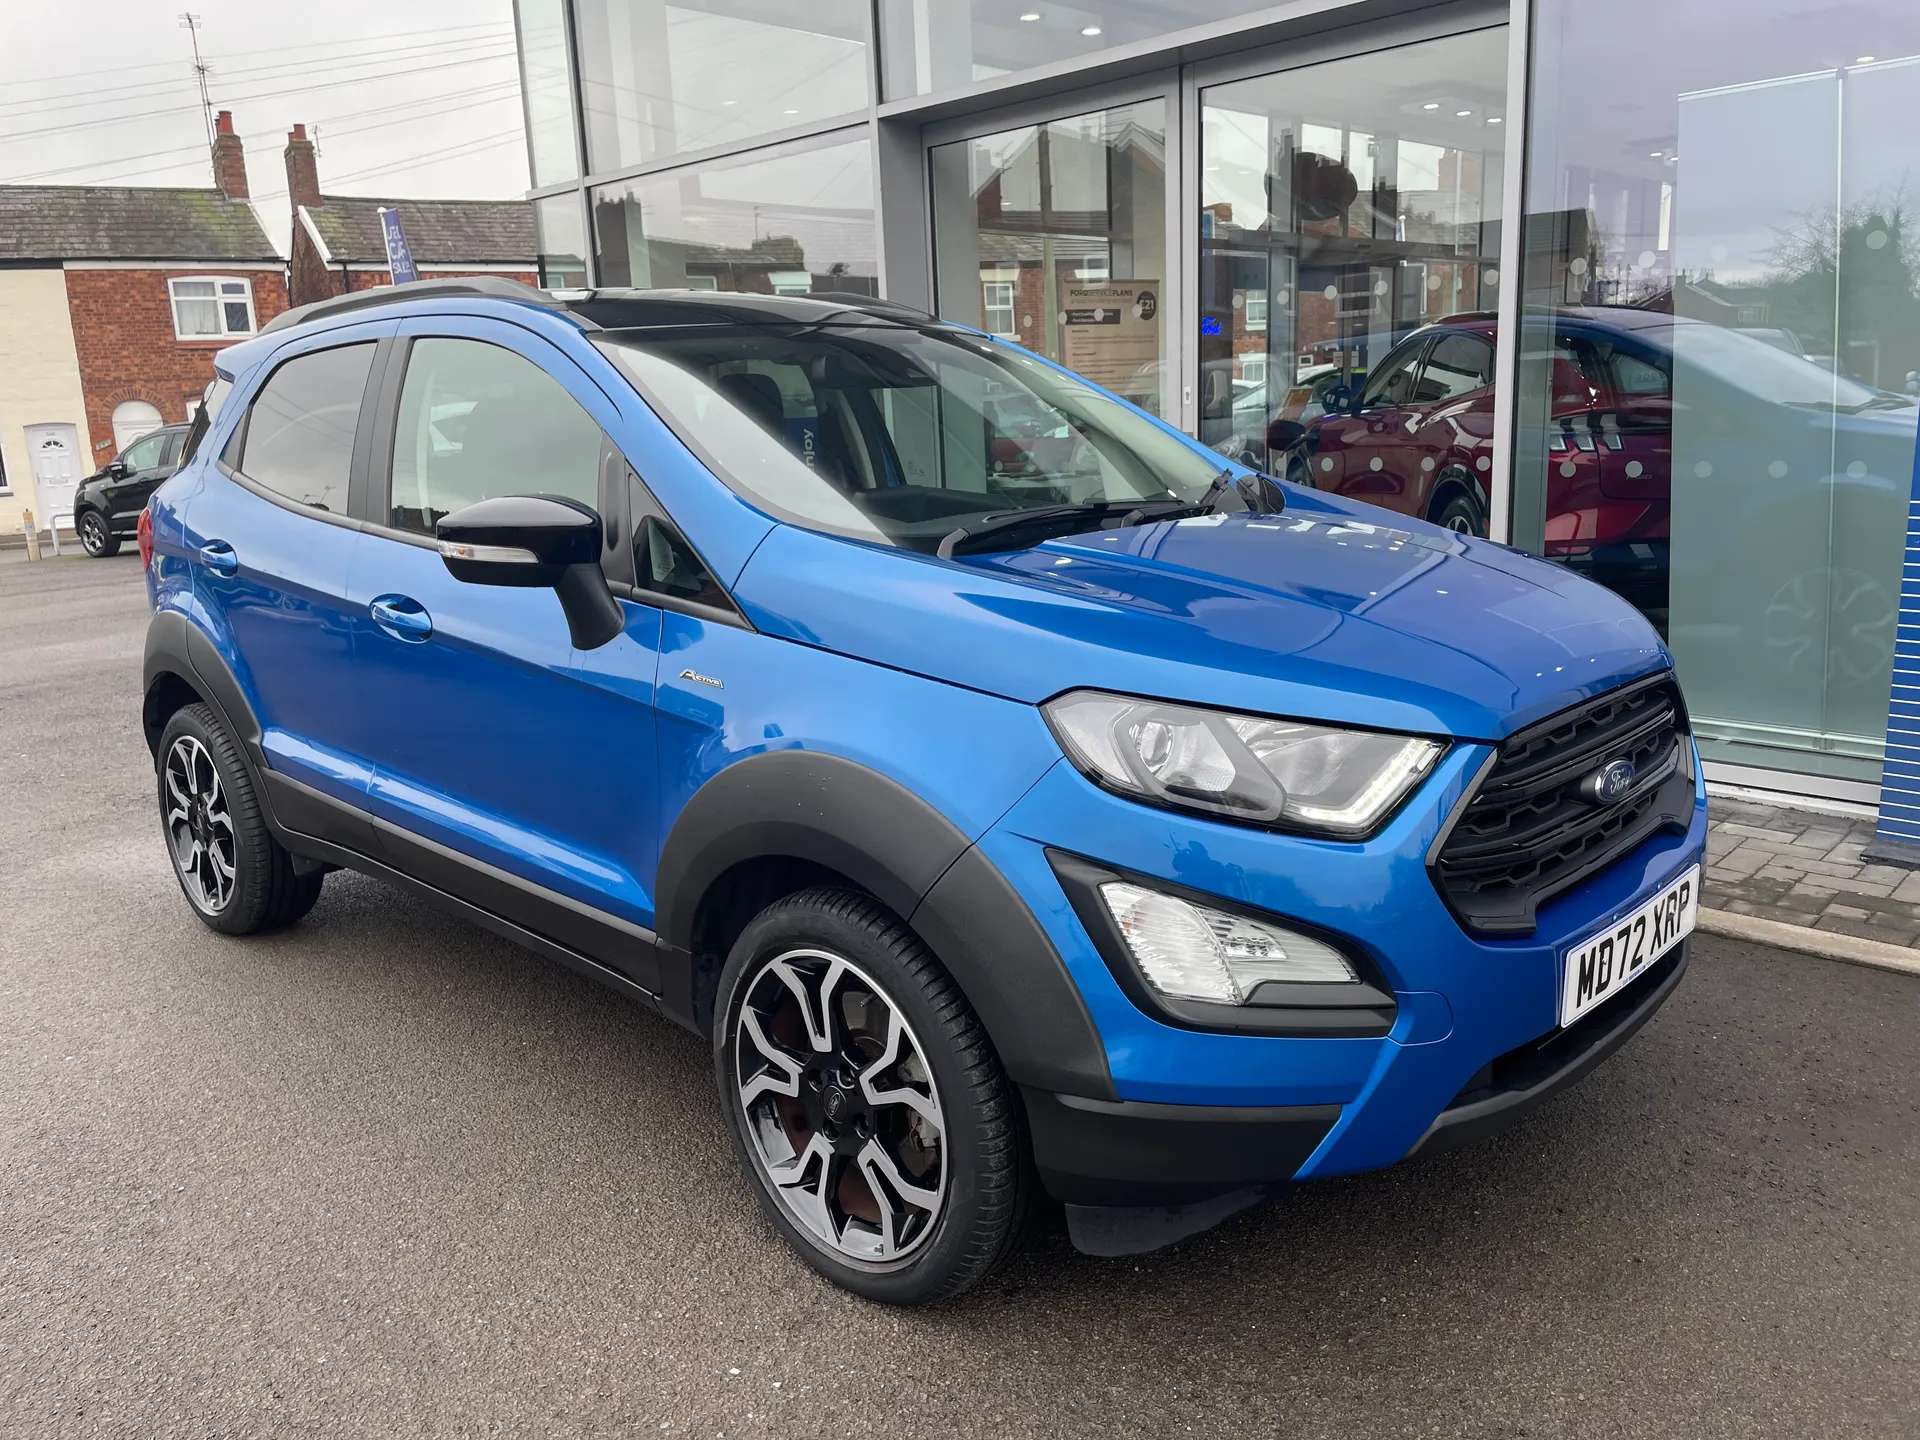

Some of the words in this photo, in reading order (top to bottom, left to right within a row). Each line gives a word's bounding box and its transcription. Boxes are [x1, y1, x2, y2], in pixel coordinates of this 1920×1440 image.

[803, 428, 816, 472] njoy
[1610, 768, 1632, 794] Ford
[1576, 922, 1647, 1009] MD72
[1650, 881, 1690, 955] XRP
